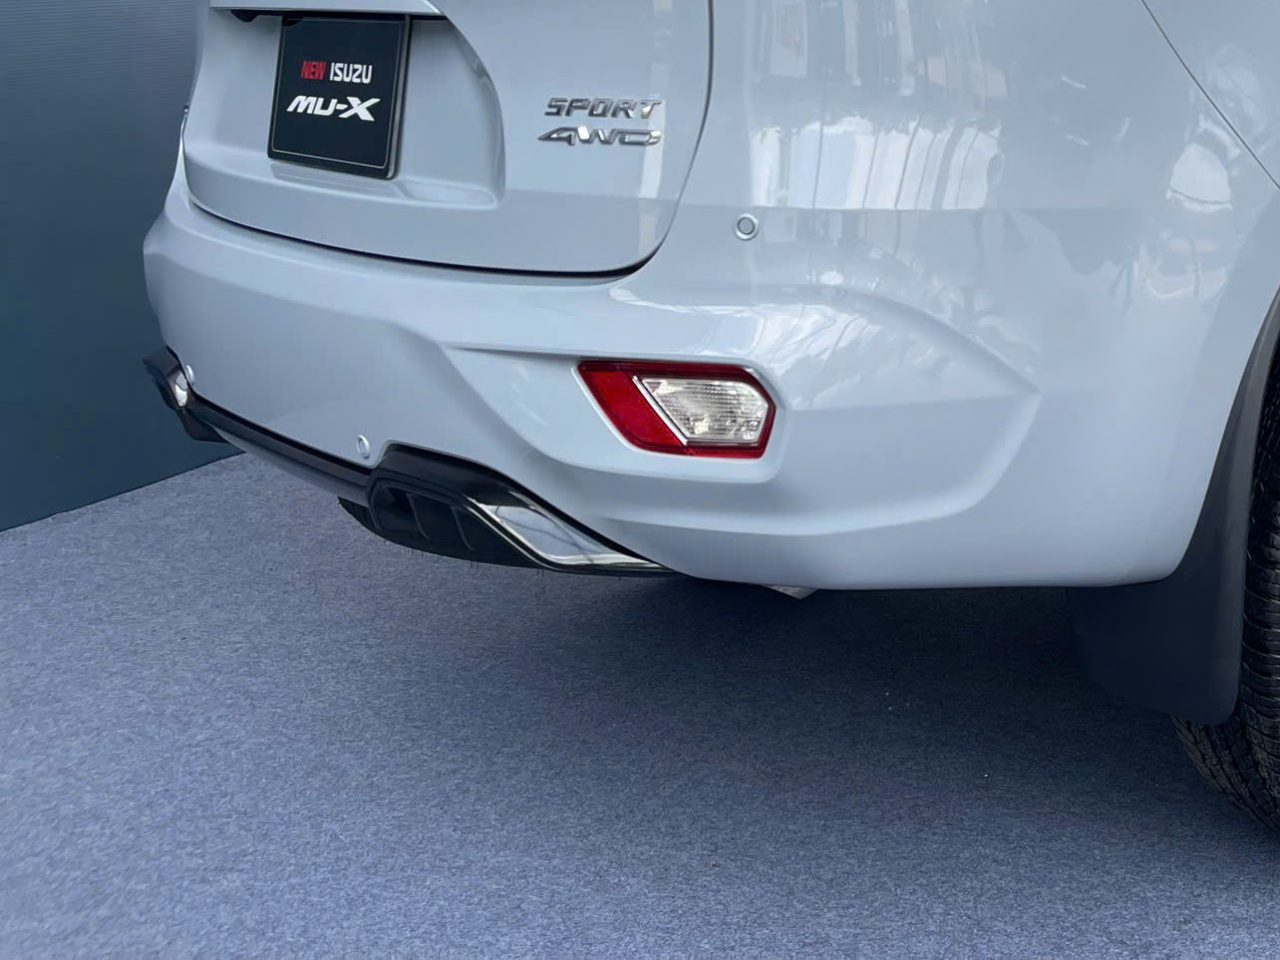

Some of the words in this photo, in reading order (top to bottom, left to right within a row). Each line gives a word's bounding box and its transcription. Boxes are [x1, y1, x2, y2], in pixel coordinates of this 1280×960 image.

[301, 61, 325, 80] NEW
[329, 63, 372, 84] ISUZU
[544, 97, 662, 118] SPORT
[537, 126, 663, 146] 4WD
